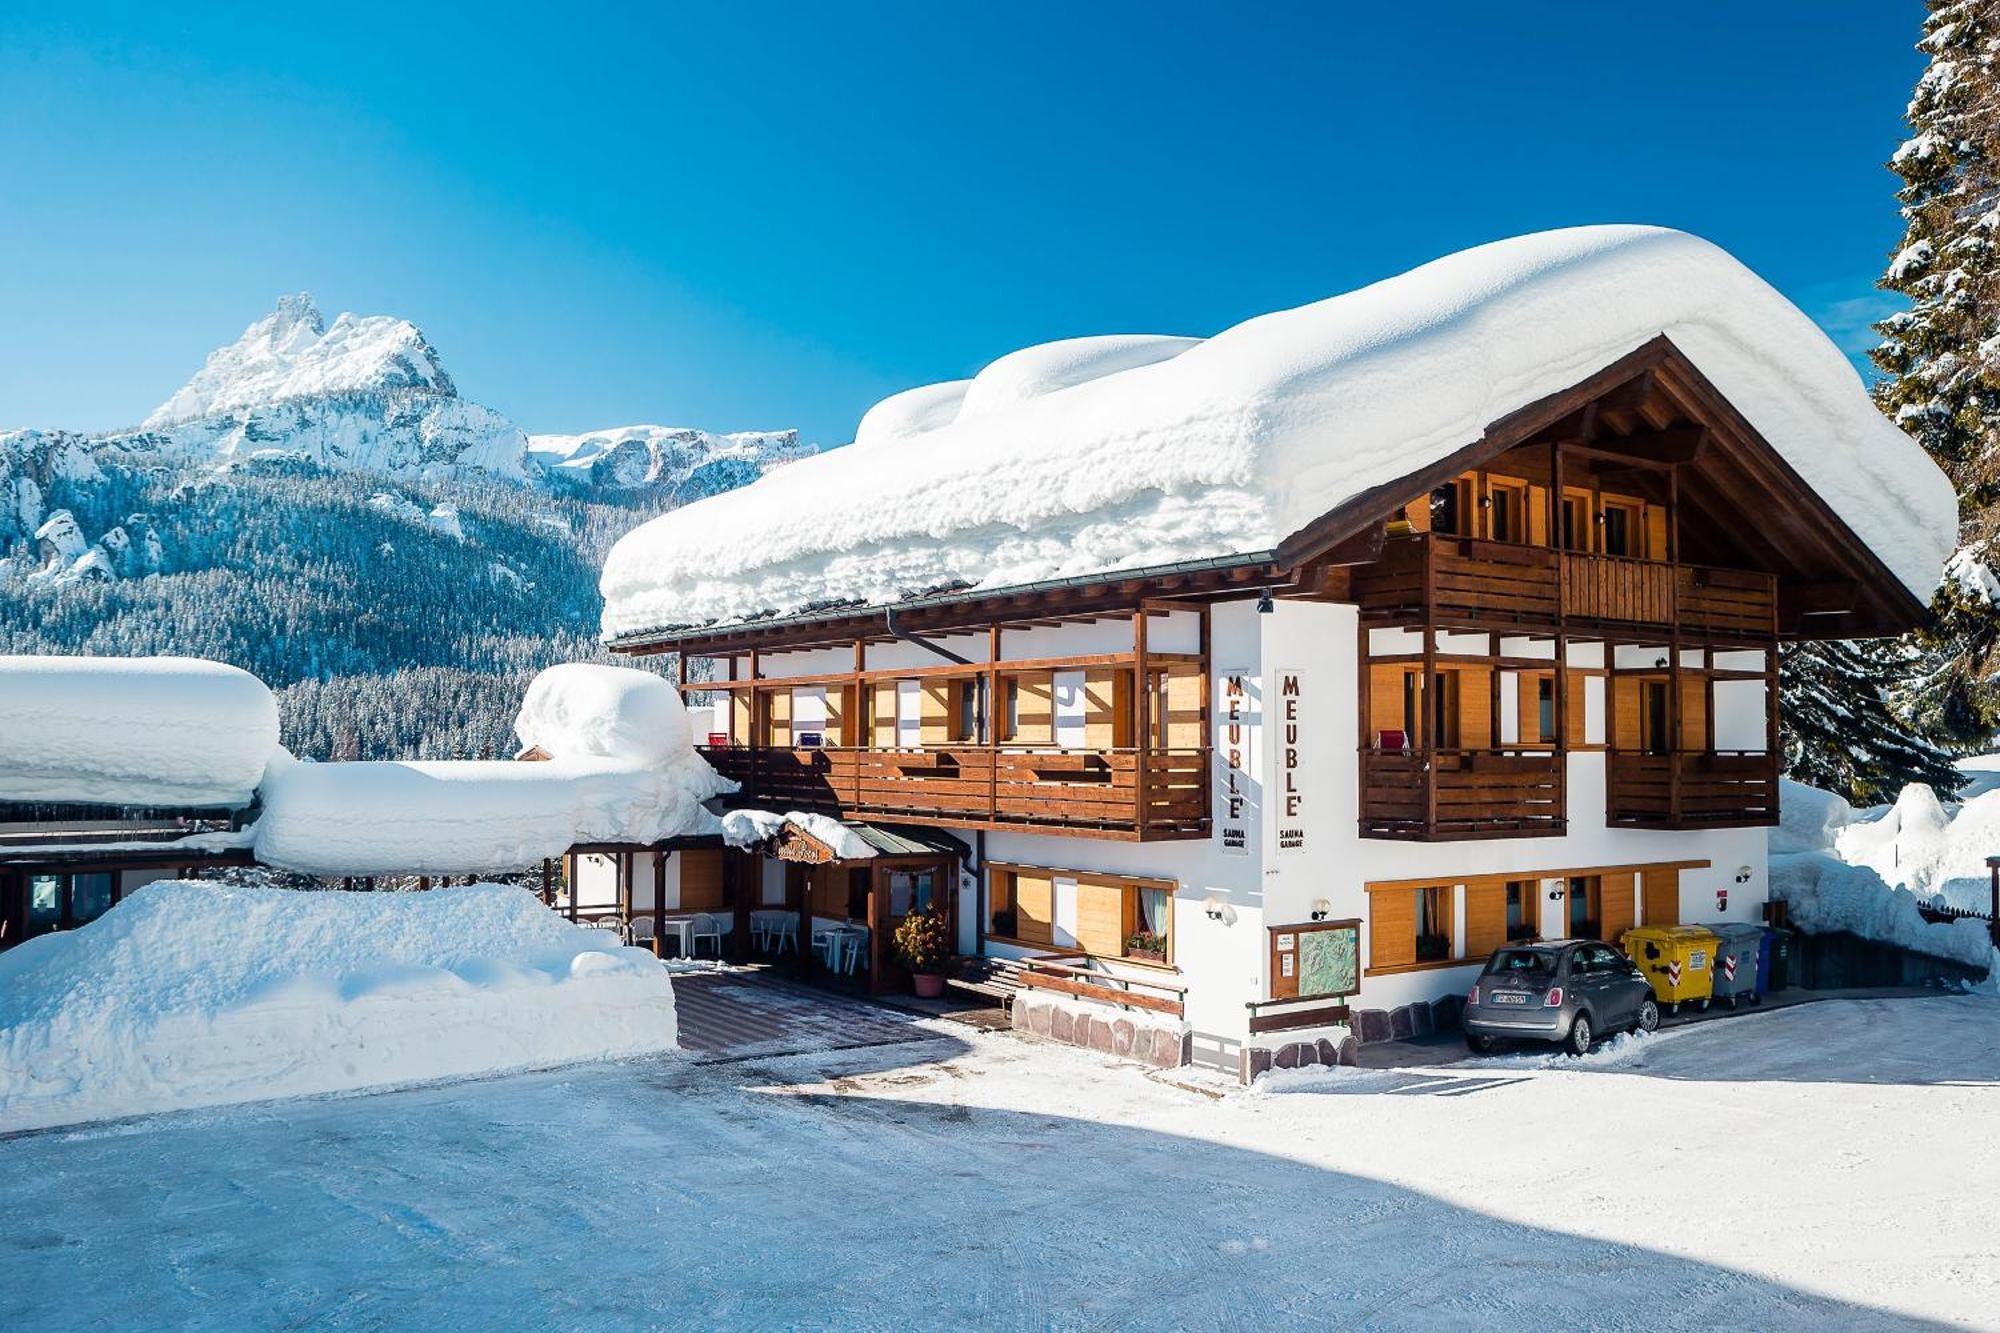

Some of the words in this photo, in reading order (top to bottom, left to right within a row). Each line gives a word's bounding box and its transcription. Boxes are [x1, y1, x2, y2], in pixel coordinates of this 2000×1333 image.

[1223, 828, 1245, 839] SAUNA
[1279, 829, 1304, 839] SAUNA
[1280, 839, 1303, 849] GARAGE
